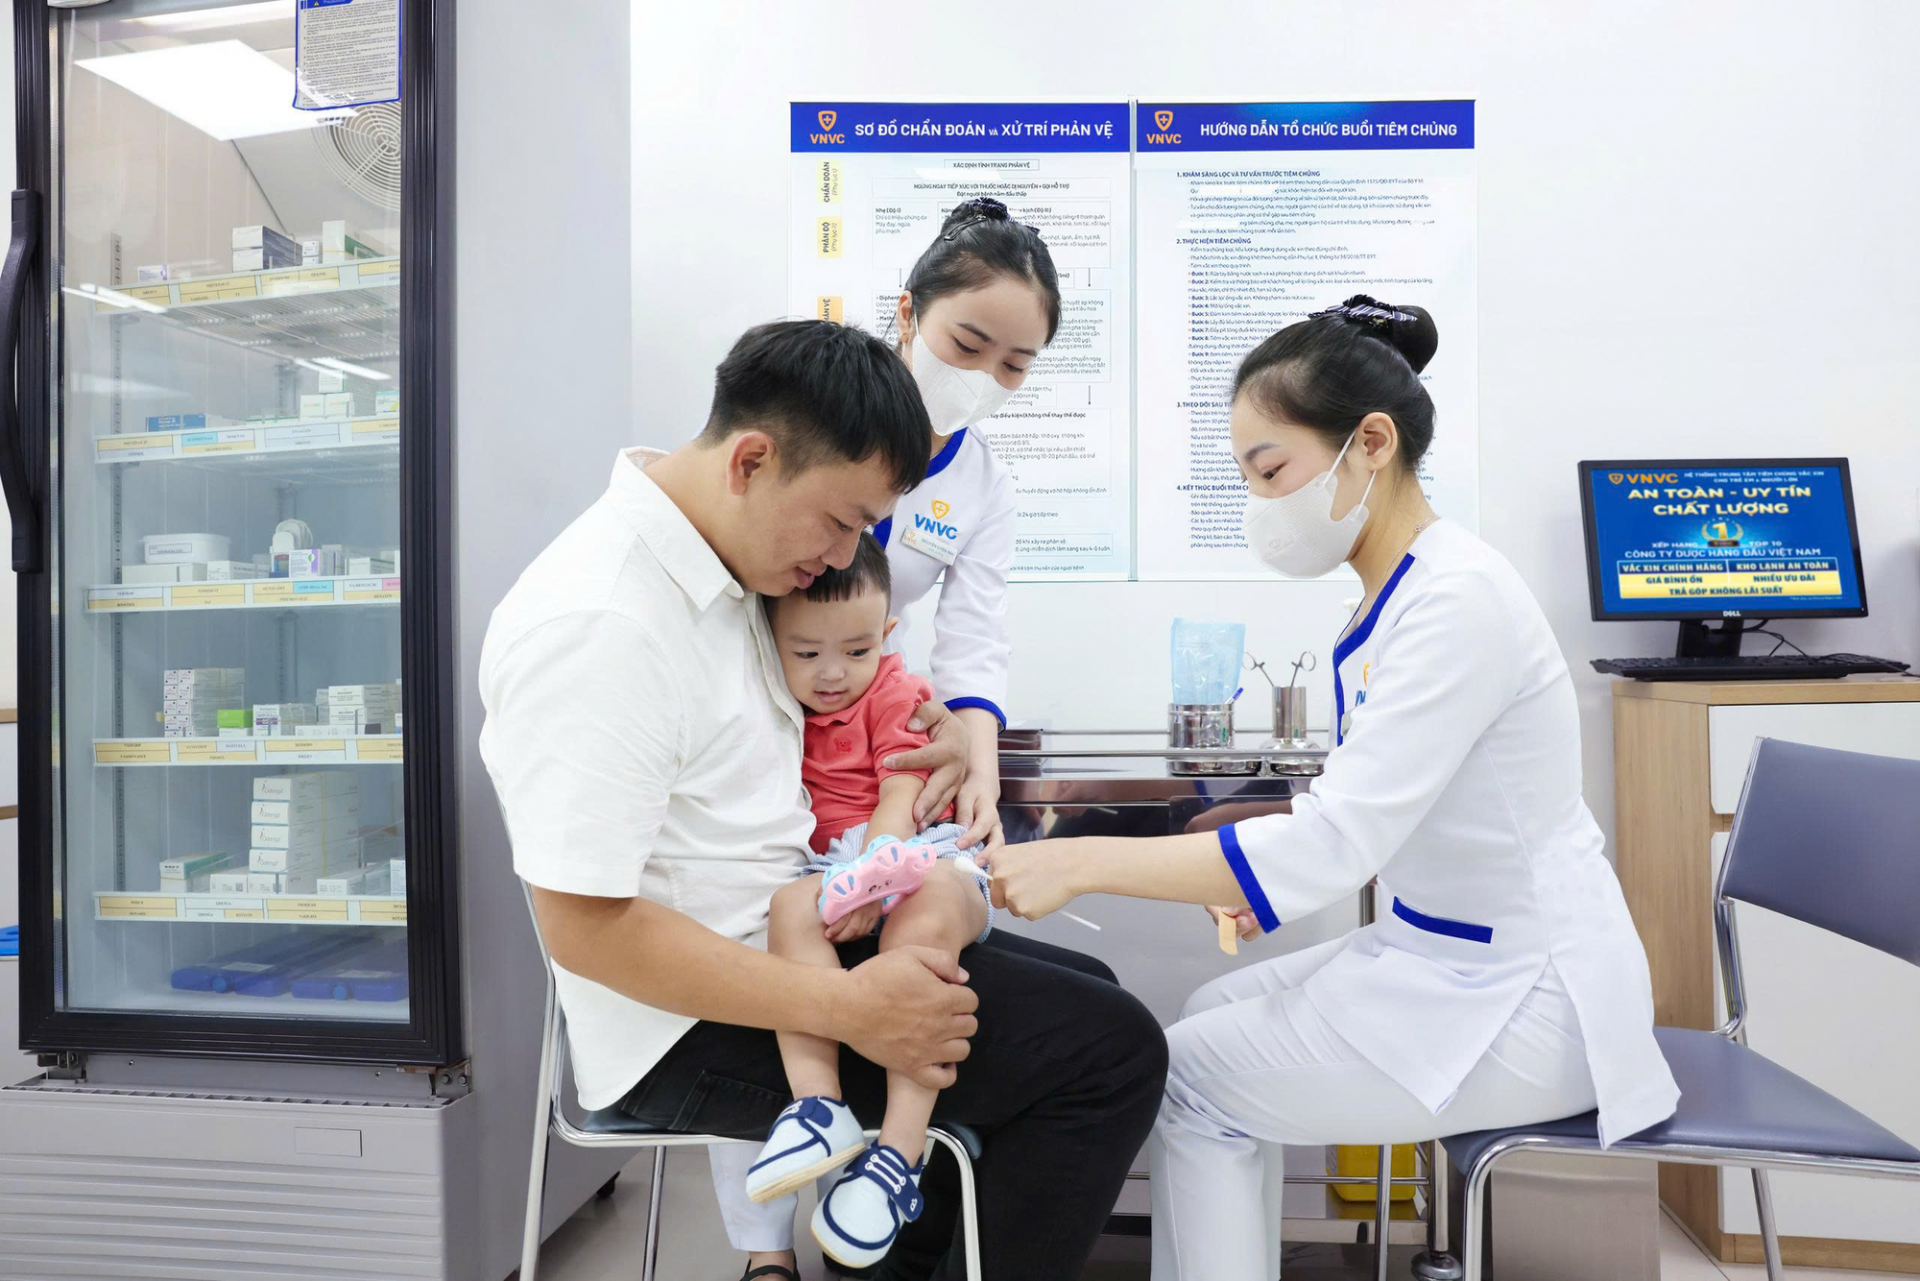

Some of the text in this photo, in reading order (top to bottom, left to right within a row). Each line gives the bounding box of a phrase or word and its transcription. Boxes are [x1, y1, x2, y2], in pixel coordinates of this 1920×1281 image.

[855, 122, 875, 136] SƠ
[877, 118, 898, 136] ĐỒ
[900, 119, 941, 136] CHẨN
[944, 120, 985, 136] ĐOÁN
[1001, 120, 1023, 136] XỬ
[1025, 120, 1048, 136] TRÍ
[1050, 120, 1091, 136] PHẢN
[1094, 121, 1113, 139] VỆ
[1200, 119, 1458, 136] HƯỚNG DẪN TỔ CHỨC BUỔI TIÊM CHỦNG
[810, 133, 845, 144] VNVC
[1146, 133, 1182, 144] VNVC
[1183, 170, 1200, 178] KHÁM
[1201, 170, 1218, 178] SÀNG
[1219, 171, 1230, 179] LỌC
[1231, 170, 1240, 178] VÀ
[1249, 169, 1262, 178] VẤN
[1262, 170, 1282, 178] TRƯỚC
[1284, 170, 1298, 178] TIÊM
[1299, 169, 1320, 177] CHỦNG
[821, 161, 830, 203] CHẨN ĐOÁN
[822, 222, 830, 253] PHÂN ĐỘ
[1230, 237, 1252, 245] CHỦNG
[1626, 473, 1679, 484] VNVC
[1628, 489, 1659, 499] AN
[1664, 486, 1724, 499] TOÀN
[1743, 487, 1772, 498] UY
[1776, 484, 1812, 497] TÍN
[1653, 500, 1789, 517] CHẤT LƯỢNG
[914, 513, 959, 540] VNVC
[1712, 522, 1728, 540] 1
[1624, 547, 1821, 559] CÔNG TY DƯỢC HÀNG ĐẦU VIỆT NAM
[1622, 563, 1641, 572] VẮC
[1662, 563, 1694, 571] CHÍNH
[1696, 563, 1724, 571] HÃNG
[1759, 562, 1786, 571] LẠNH
[1788, 562, 1801, 570] AN
[1804, 561, 1830, 569] TOÀN
[1646, 575, 1703, 584] GIÁ BÌNH ỔN
[1753, 573, 1816, 583] NHIỀU ƯU ĐÃI
[1669, 586, 1782, 596] TRẢ GÓP KHÔNG LÃI SUẤT
